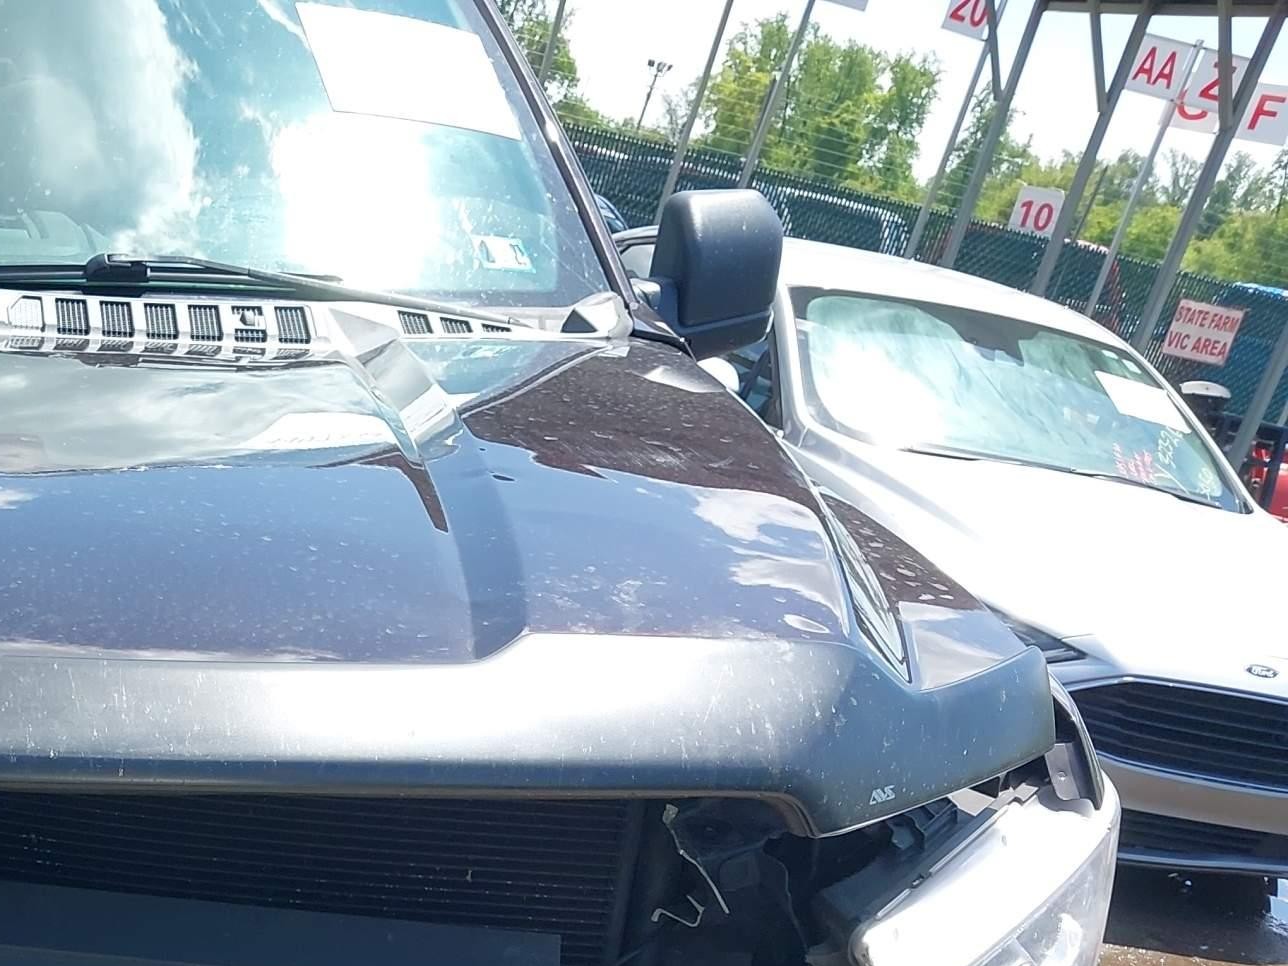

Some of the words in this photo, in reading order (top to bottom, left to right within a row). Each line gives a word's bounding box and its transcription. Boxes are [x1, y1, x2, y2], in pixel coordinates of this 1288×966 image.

[1132, 46, 1177, 89] AA
[1247, 94, 1287, 130] F
[1019, 200, 1054, 231] 10
[1175, 305, 1209, 328] STATE
[1208, 312, 1240, 333] FARM
[1167, 330, 1190, 350] VIC
[1191, 336, 1228, 358] AREA
